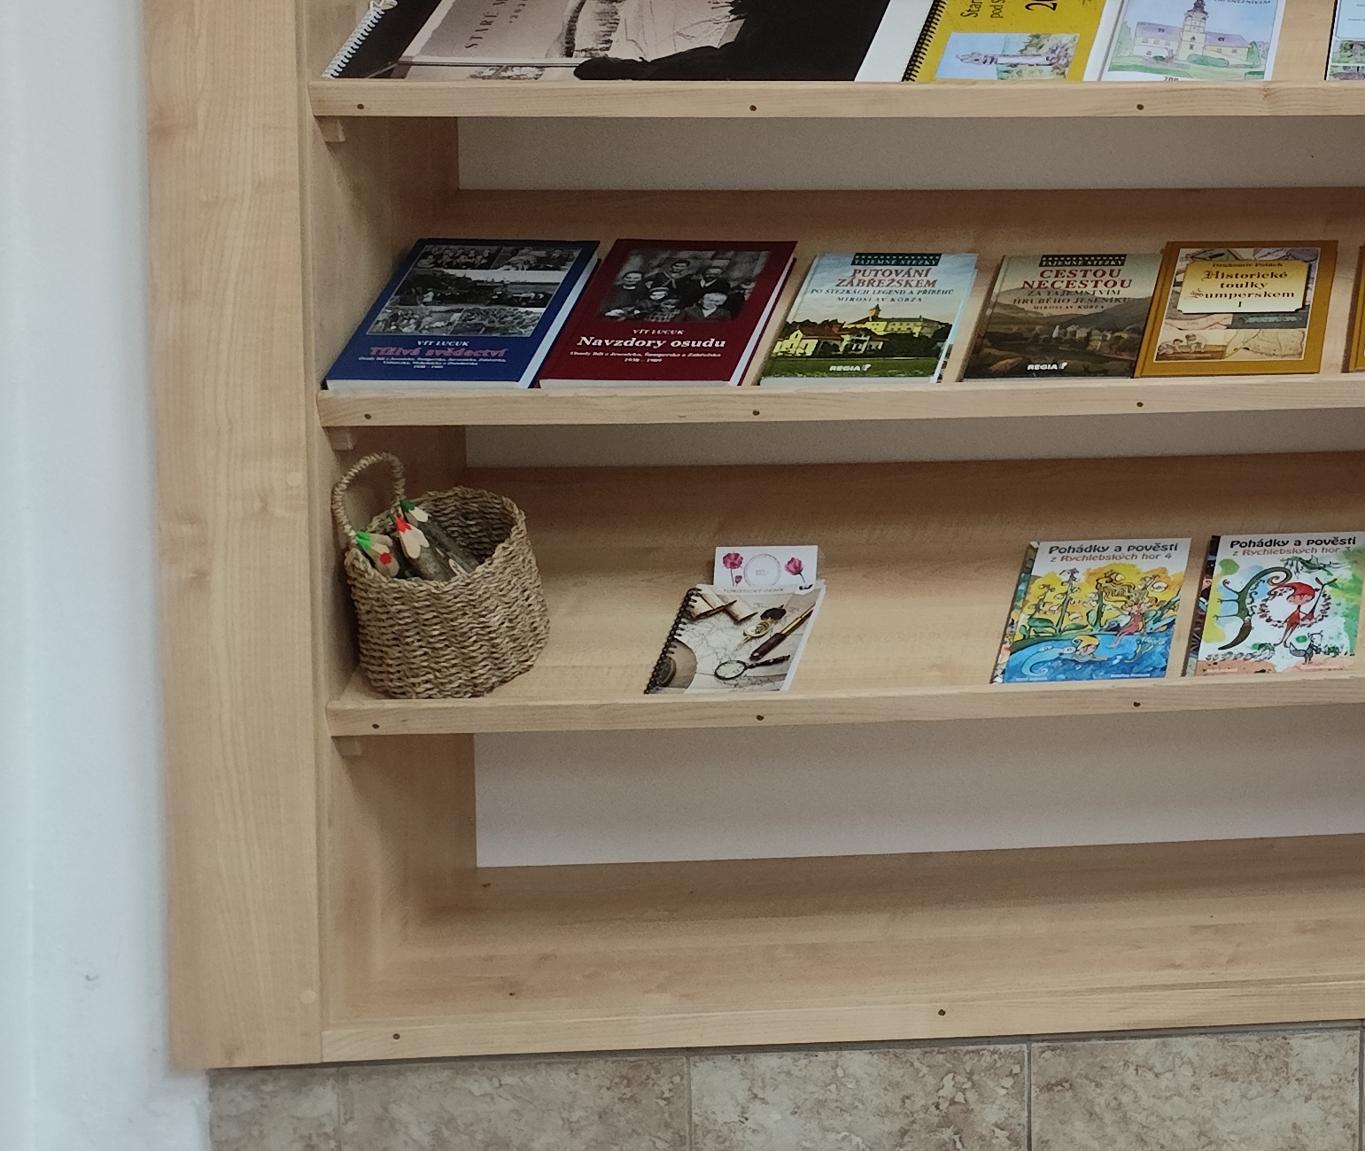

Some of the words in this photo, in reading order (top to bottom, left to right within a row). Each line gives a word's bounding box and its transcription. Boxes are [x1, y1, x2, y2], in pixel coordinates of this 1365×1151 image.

[990, 0, 1004, 19] pod
[851, 267, 931, 278] PUTOVÁNÍ
[1039, 269, 1122, 279] CESTOU
[1201, 270, 1288, 282] Historické
[834, 278, 938, 289] ZÁBŘEŽSKEM
[1022, 279, 1133, 289] NECESTOU
[1220, 282, 1268, 290] toulky
[1190, 288, 1295, 299] Šumperskem
[1013, 297, 1070, 305] HRUBÉHO
[577, 336, 667, 349] Navzdory
[670, 338, 726, 348] osudu
[1230, 538, 1289, 549] Pohádky
[1306, 536, 1356, 547] pověsti
[1048, 544, 1109, 555] Pohádky
[1127, 542, 1179, 553] pověsti
[1242, 547, 1318, 556] Rychlebských
[1321, 546, 1340, 554] hor
[1060, 552, 1138, 562] Rychlebských
